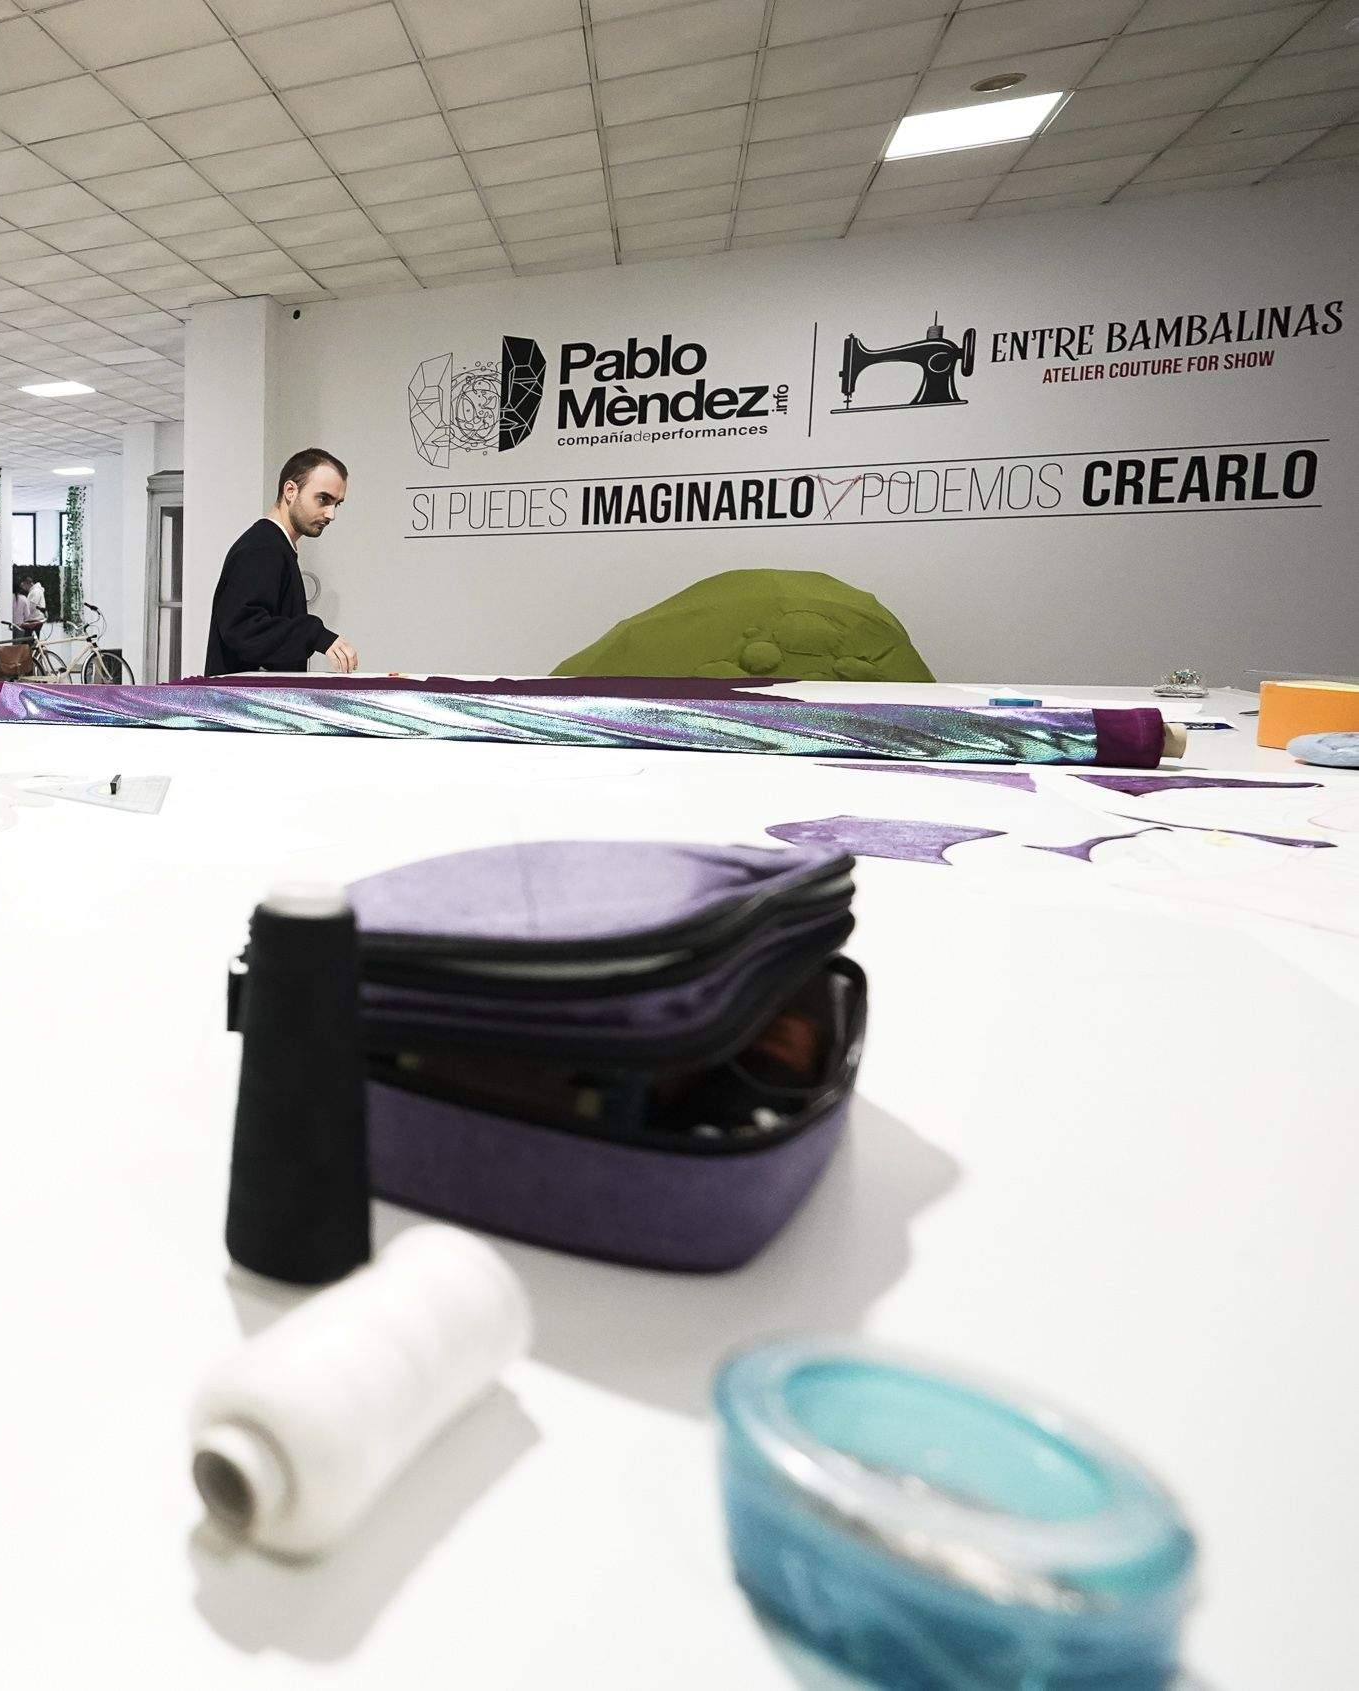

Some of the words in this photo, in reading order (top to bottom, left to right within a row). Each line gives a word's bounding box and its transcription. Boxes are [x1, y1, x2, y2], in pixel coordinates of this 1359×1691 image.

[991, 323, 1095, 364] ENTRE
[1106, 300, 1344, 354] BAMBALINAS
[560, 334, 708, 385] Pablo
[1042, 363, 1105, 384] ATELIER
[1109, 357, 1183, 379] COUTURE
[1187, 353, 1219, 373] FOR
[1224, 349, 1276, 370] SHOW
[557, 379, 769, 430] Mèndez
[772, 383, 789, 415] .info
[412, 490, 436, 531] SI
[448, 487, 568, 530] PUEDES
[581, 474, 815, 526] IMAGINARLO
[861, 462, 1064, 516] PODEMOS
[1082, 449, 1318, 507] CREARLO
